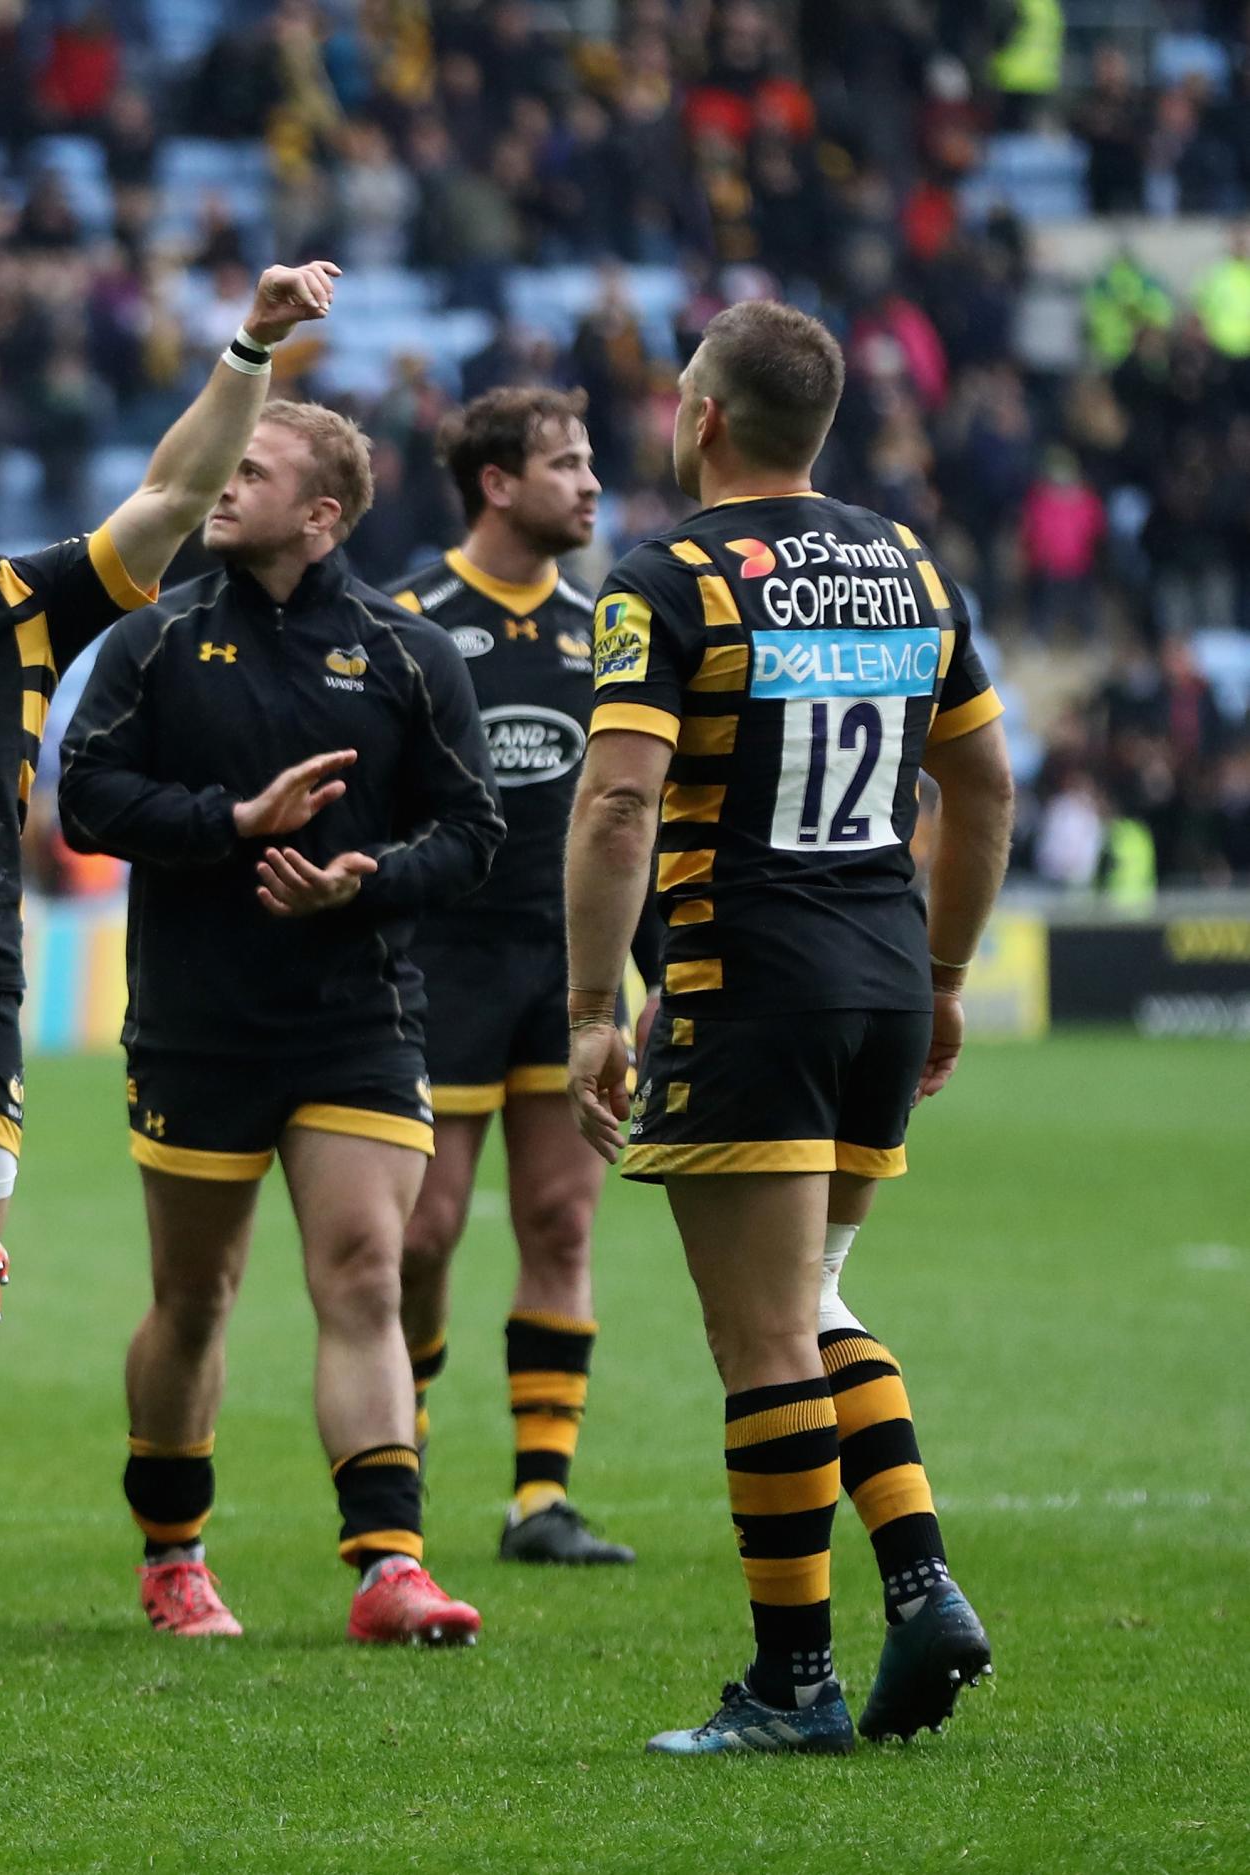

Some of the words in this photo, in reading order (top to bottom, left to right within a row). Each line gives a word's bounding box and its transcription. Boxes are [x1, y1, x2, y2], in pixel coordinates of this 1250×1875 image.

[775, 531, 830, 569] DS
[824, 532, 909, 569] Smith
[762, 575, 921, 627] GOPPERTH
[755, 642, 854, 683] DELL
[854, 641, 938, 682] EMC
[324, 676, 365, 692] WASPS
[798, 700, 884, 845] 12
